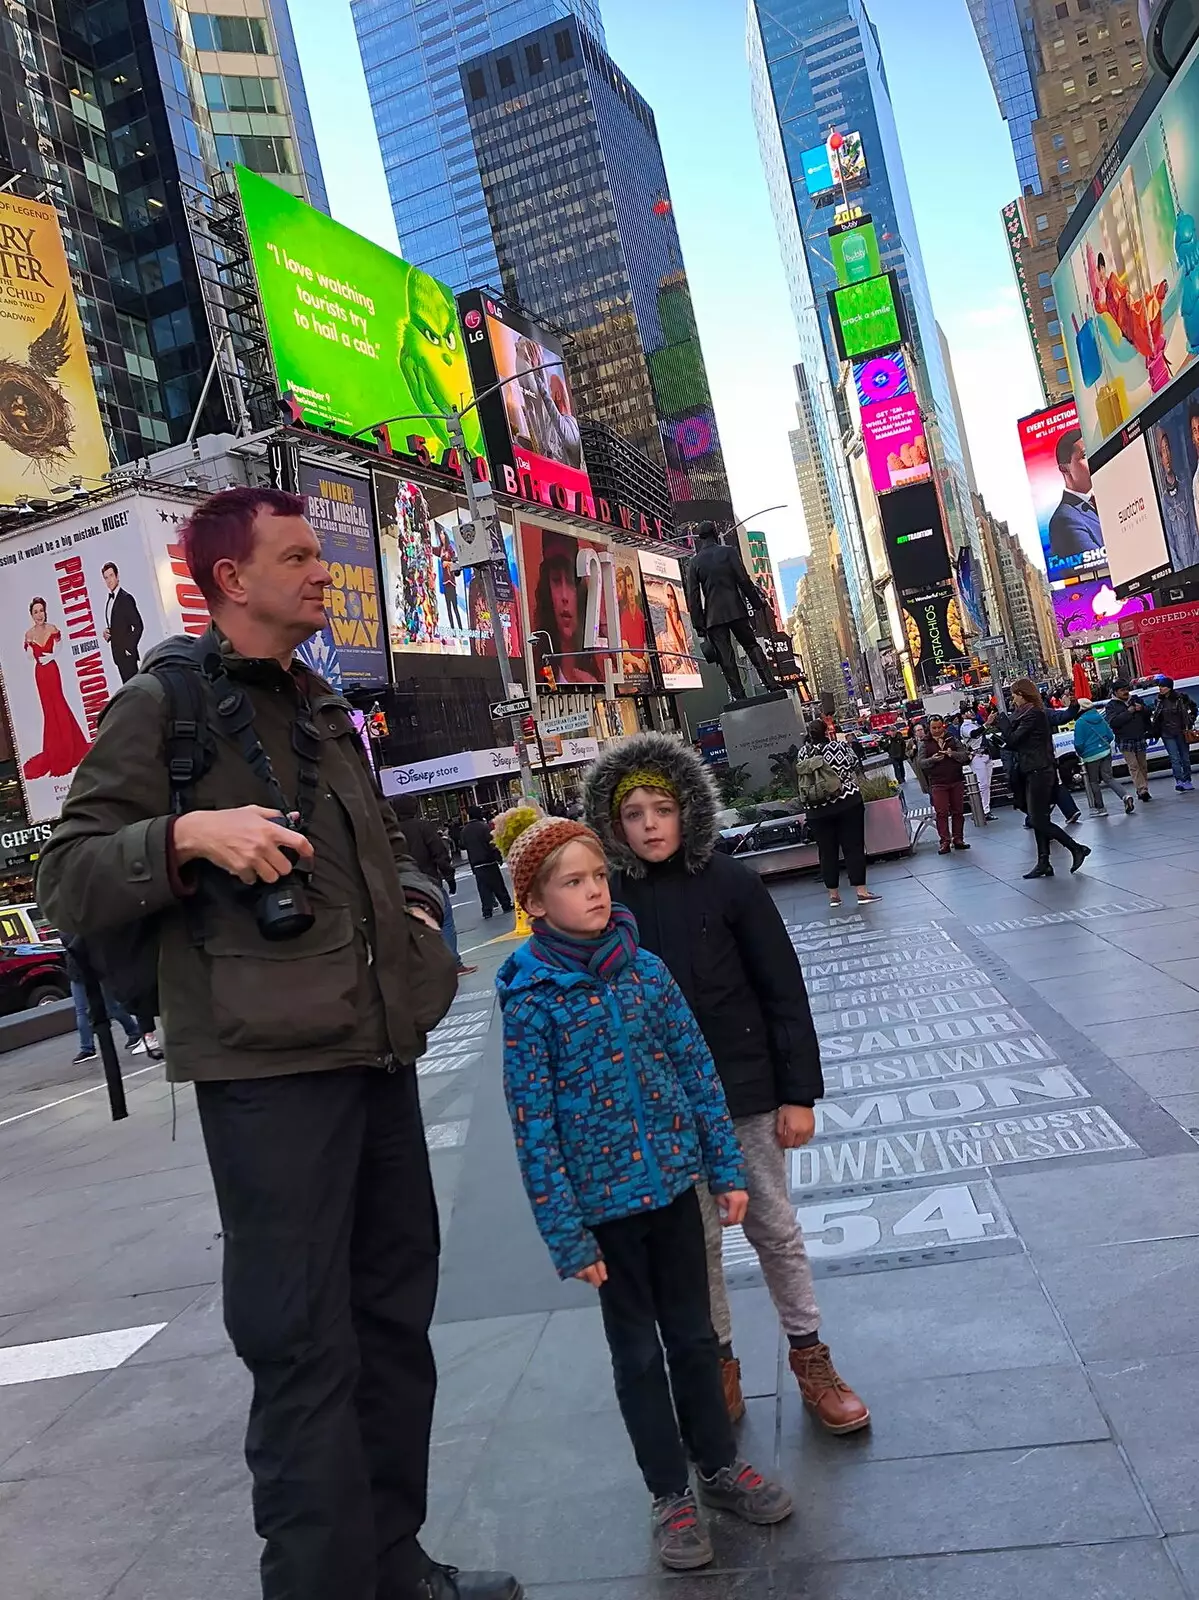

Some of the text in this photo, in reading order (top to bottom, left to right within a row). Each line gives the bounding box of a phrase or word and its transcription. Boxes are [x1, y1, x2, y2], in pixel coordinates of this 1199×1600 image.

[0, 223, 36, 257] RY
[6, 286, 46, 304] CHILD
[283, 249, 314, 281] love
[316, 271, 376, 316] watching
[19, 301, 35, 310] TWO
[296, 283, 367, 335] tourists try
[494, 304, 503, 320] LG
[842, 313, 864, 327] crack
[871, 304, 891, 317] smile
[294, 308, 310, 330] to
[311, 312, 339, 342] hail
[341, 332, 351, 348] a
[469, 330, 484, 344] LG
[286, 379, 331, 404] November 9
[865, 418, 887, 429] WHILE
[876, 410, 889, 419] GET
[1026, 408, 1077, 434] EVERY ELECTION
[1048, 426, 1057, 435] LET
[1057, 423, 1066, 432] YOU
[1065, 418, 1079, 430] KNOW
[319, 479, 355, 504] WINNER!
[502, 463, 662, 540] BROADWAY
[308, 496, 369, 527] BEST MUSICAL
[310, 517, 370, 538] ALL ACROSS NORTH AMERICA
[18, 550, 23, 561] it
[25, 543, 44, 559] would
[45, 541, 54, 553] be
[55, 539, 60, 549] a
[61, 534, 72, 547] big
[54, 555, 97, 640] PRETTY
[576, 547, 621, 649] 21
[1141, 611, 1187, 626] COFFEED
[71, 639, 100, 656] THE MUSICAL
[925, 604, 945, 666] PISTACHIOS
[74, 651, 110, 741] WOM
[496, 702, 527, 713] ONE WAY
[489, 751, 512, 769] Disney
[709, 748, 729, 756] UNIT
[393, 767, 459, 785] Disney store
[1, 824, 52, 849] GIFTS
[840, 987, 1008, 1028] O'NEILL
[814, 1065, 1077, 1135] MON
[948, 1109, 1092, 1142] AUGUST
[948, 1124, 1118, 1168] WILSON
[797, 1184, 996, 1257] 54
[826, 1250, 960, 1272] STREET
